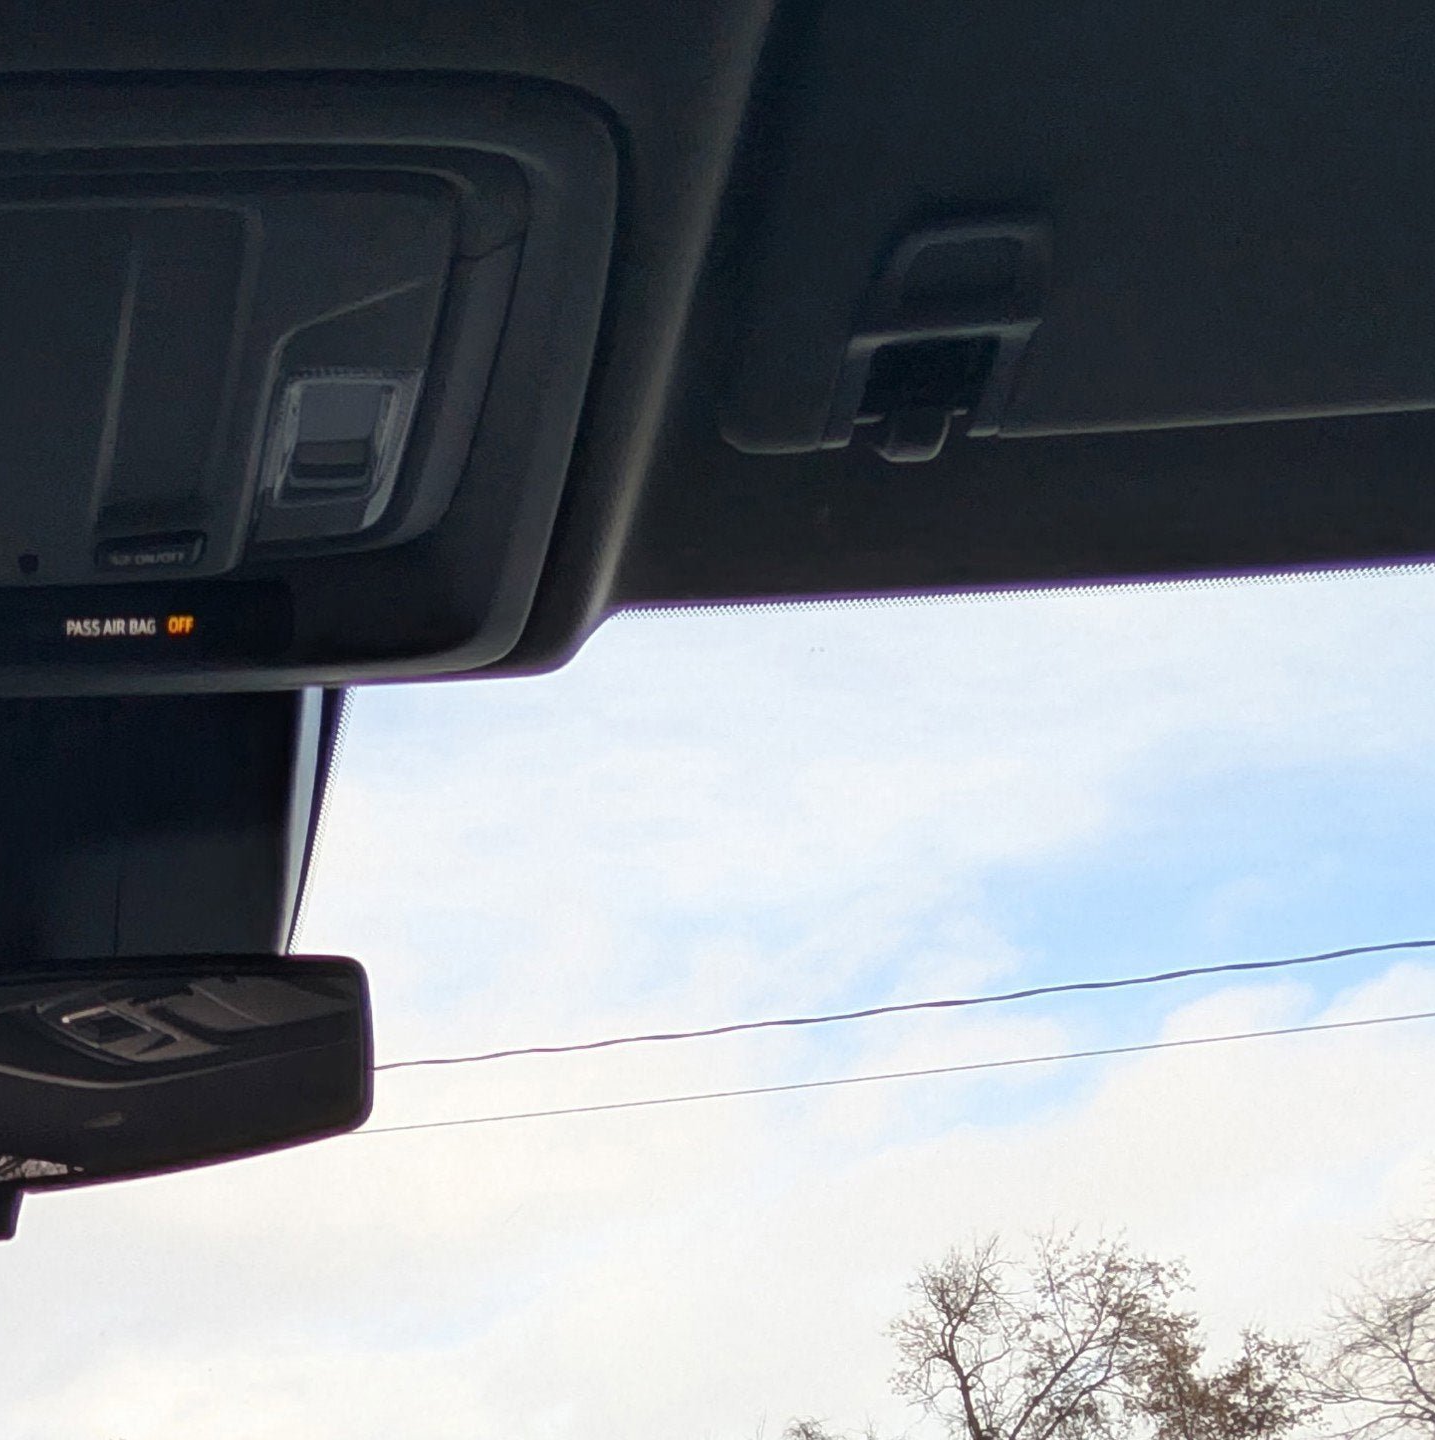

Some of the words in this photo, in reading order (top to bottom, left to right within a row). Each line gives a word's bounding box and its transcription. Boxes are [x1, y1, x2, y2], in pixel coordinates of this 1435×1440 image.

[66, 619, 100, 636] PASS
[103, 618, 125, 635] AIR
[129, 618, 156, 635] BAG
[167, 614, 194, 634] OFF
